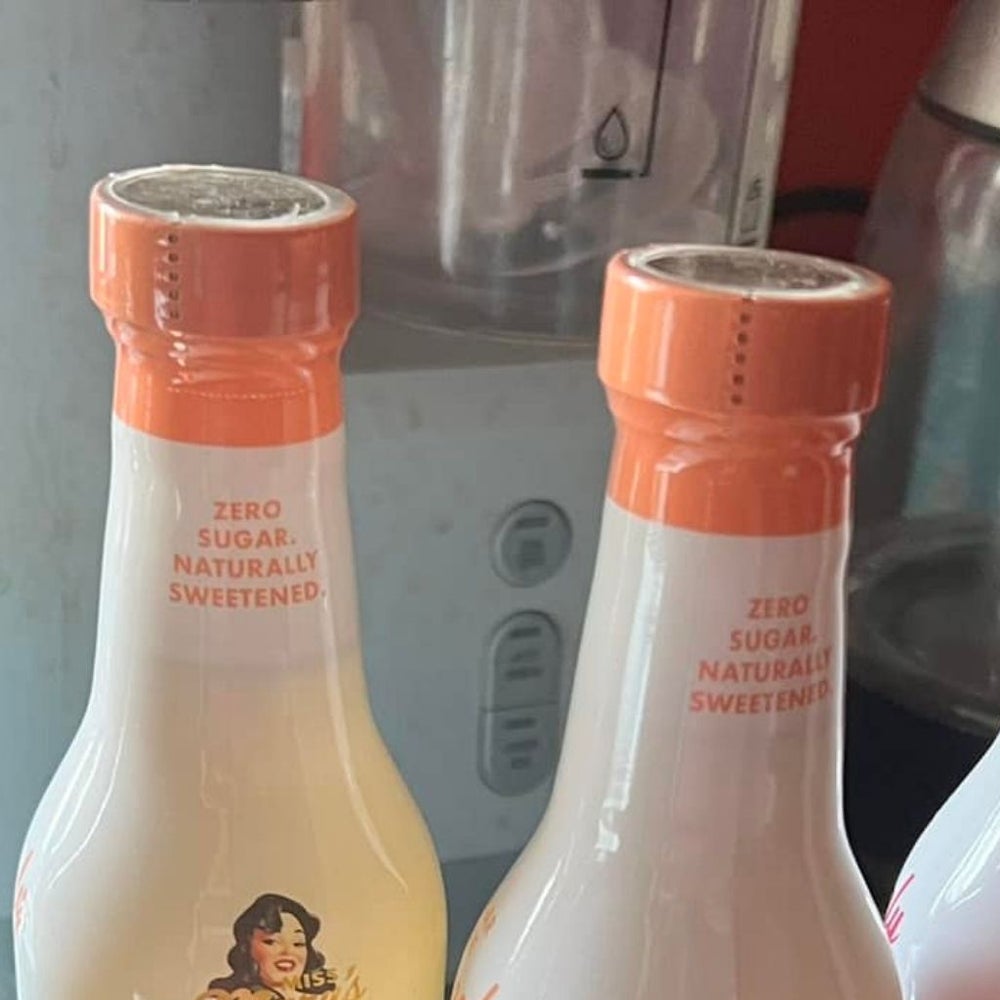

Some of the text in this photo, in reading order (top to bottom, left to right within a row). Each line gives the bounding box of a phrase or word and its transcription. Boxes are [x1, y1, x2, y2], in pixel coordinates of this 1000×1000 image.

[213, 499, 282, 521] ZERO
[198, 527, 297, 549] SUGAR.
[173, 549, 319, 578] NATURALLY
[168, 580, 326, 608] SWEETENED.
[749, 594, 809, 619] ZERO
[697, 647, 833, 683] NATURALLY
